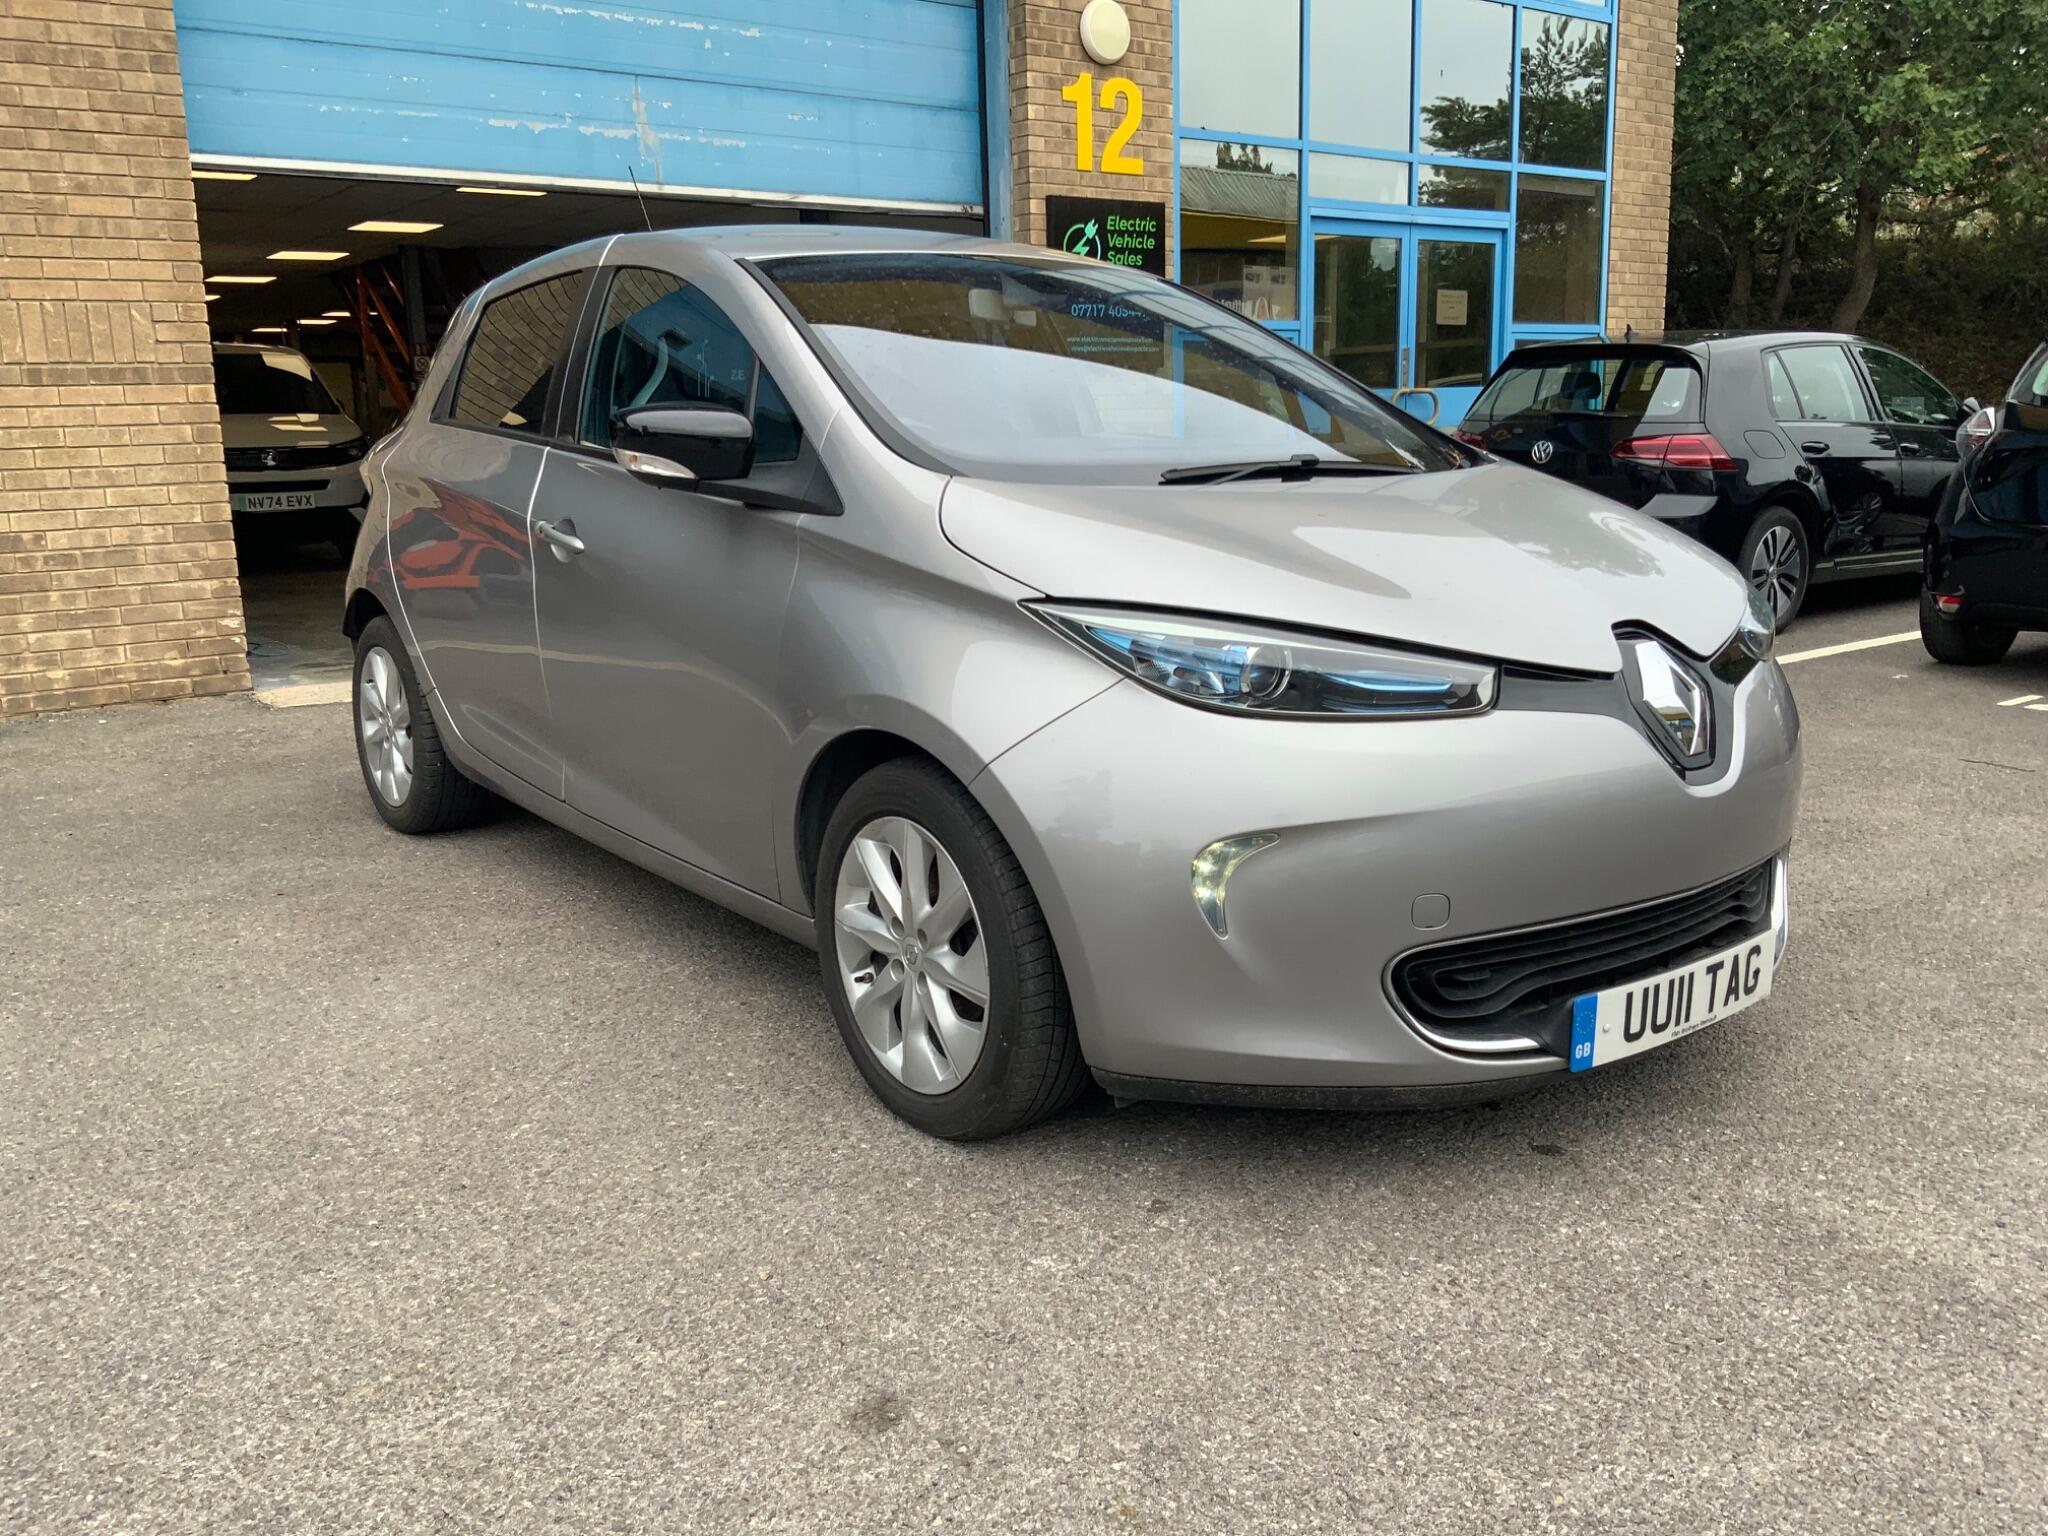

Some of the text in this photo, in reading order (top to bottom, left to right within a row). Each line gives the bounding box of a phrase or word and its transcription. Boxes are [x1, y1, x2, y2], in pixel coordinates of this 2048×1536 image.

[1062, 71, 1144, 175] 12
[1106, 216, 1157, 232] Electric
[1107, 233, 1155, 249] Vehicle
[1107, 251, 1143, 266] Sales
[1071, 303, 1106, 318] 07717
[247, 494, 313, 510] NV74 EVX
[1705, 944, 1761, 1014] TAG
[1575, 1041, 1592, 1060] GB
